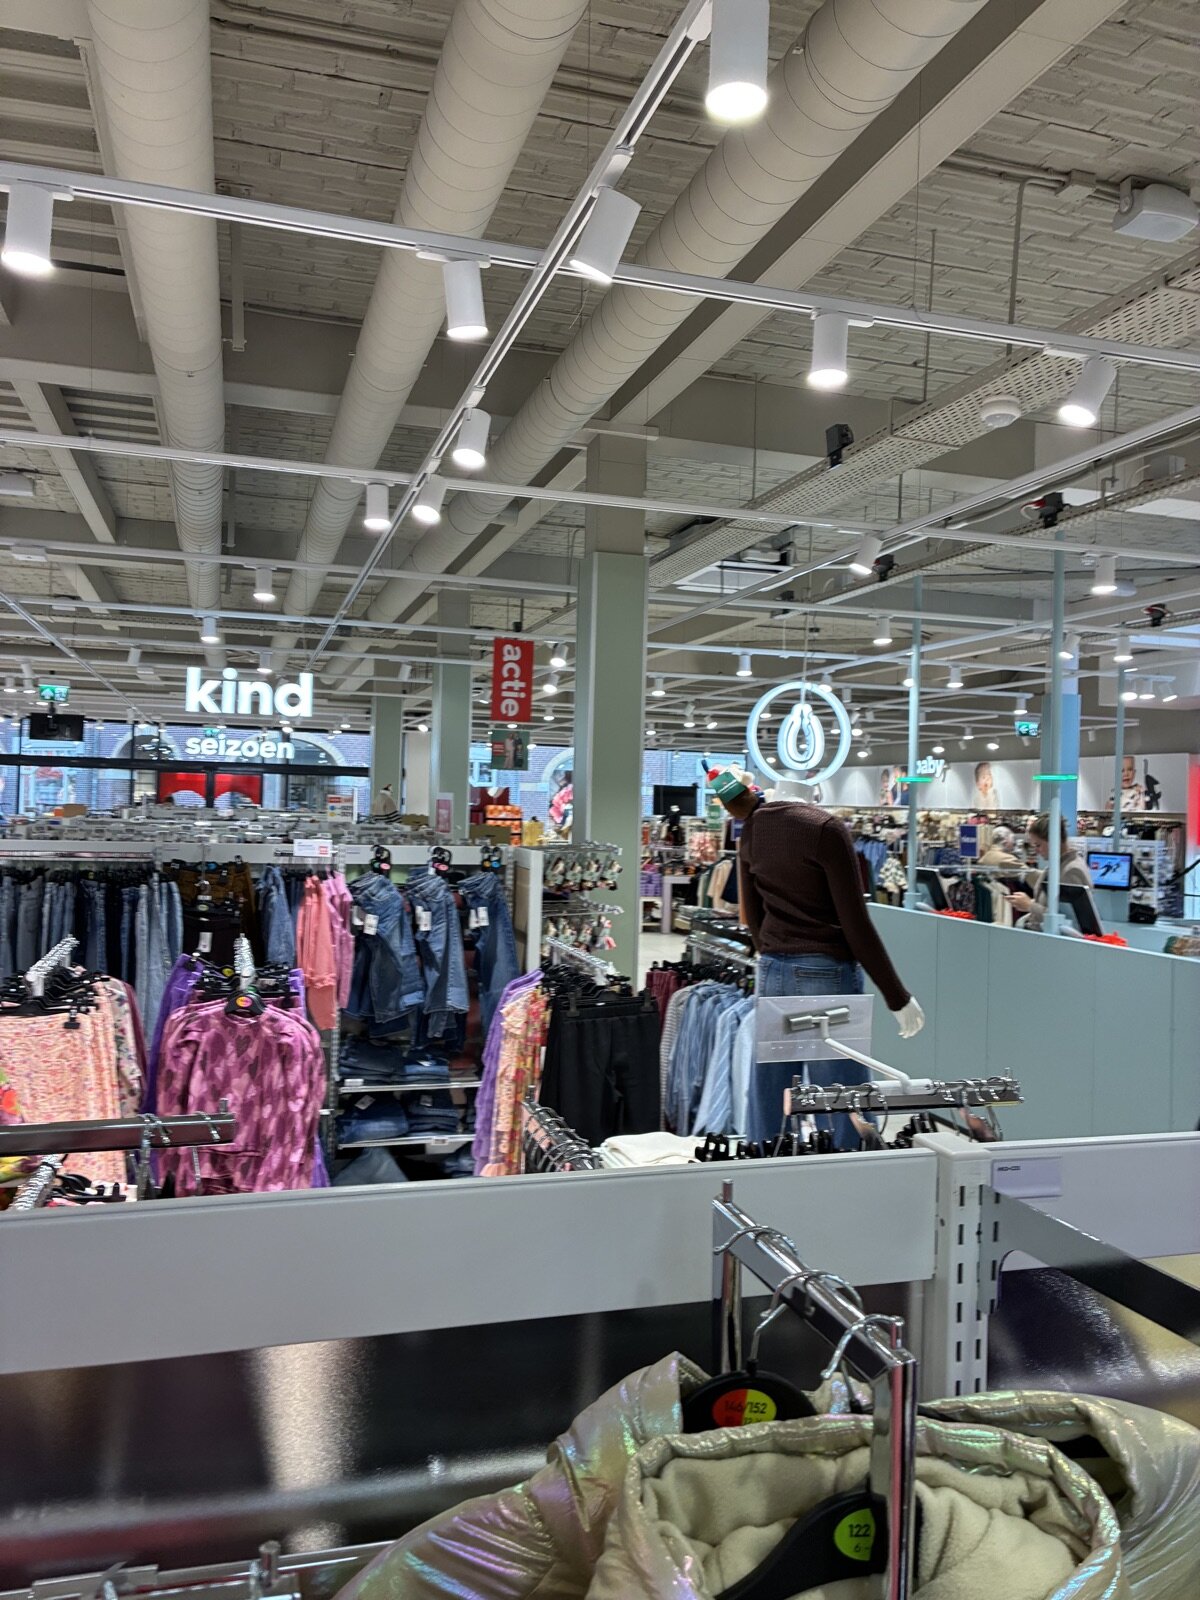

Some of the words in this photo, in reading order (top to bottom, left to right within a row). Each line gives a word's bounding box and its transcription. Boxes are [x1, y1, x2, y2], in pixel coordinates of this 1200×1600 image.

[185, 666, 314, 718] kind
[500, 643, 526, 717] actie
[184, 733, 295, 759] seizoen
